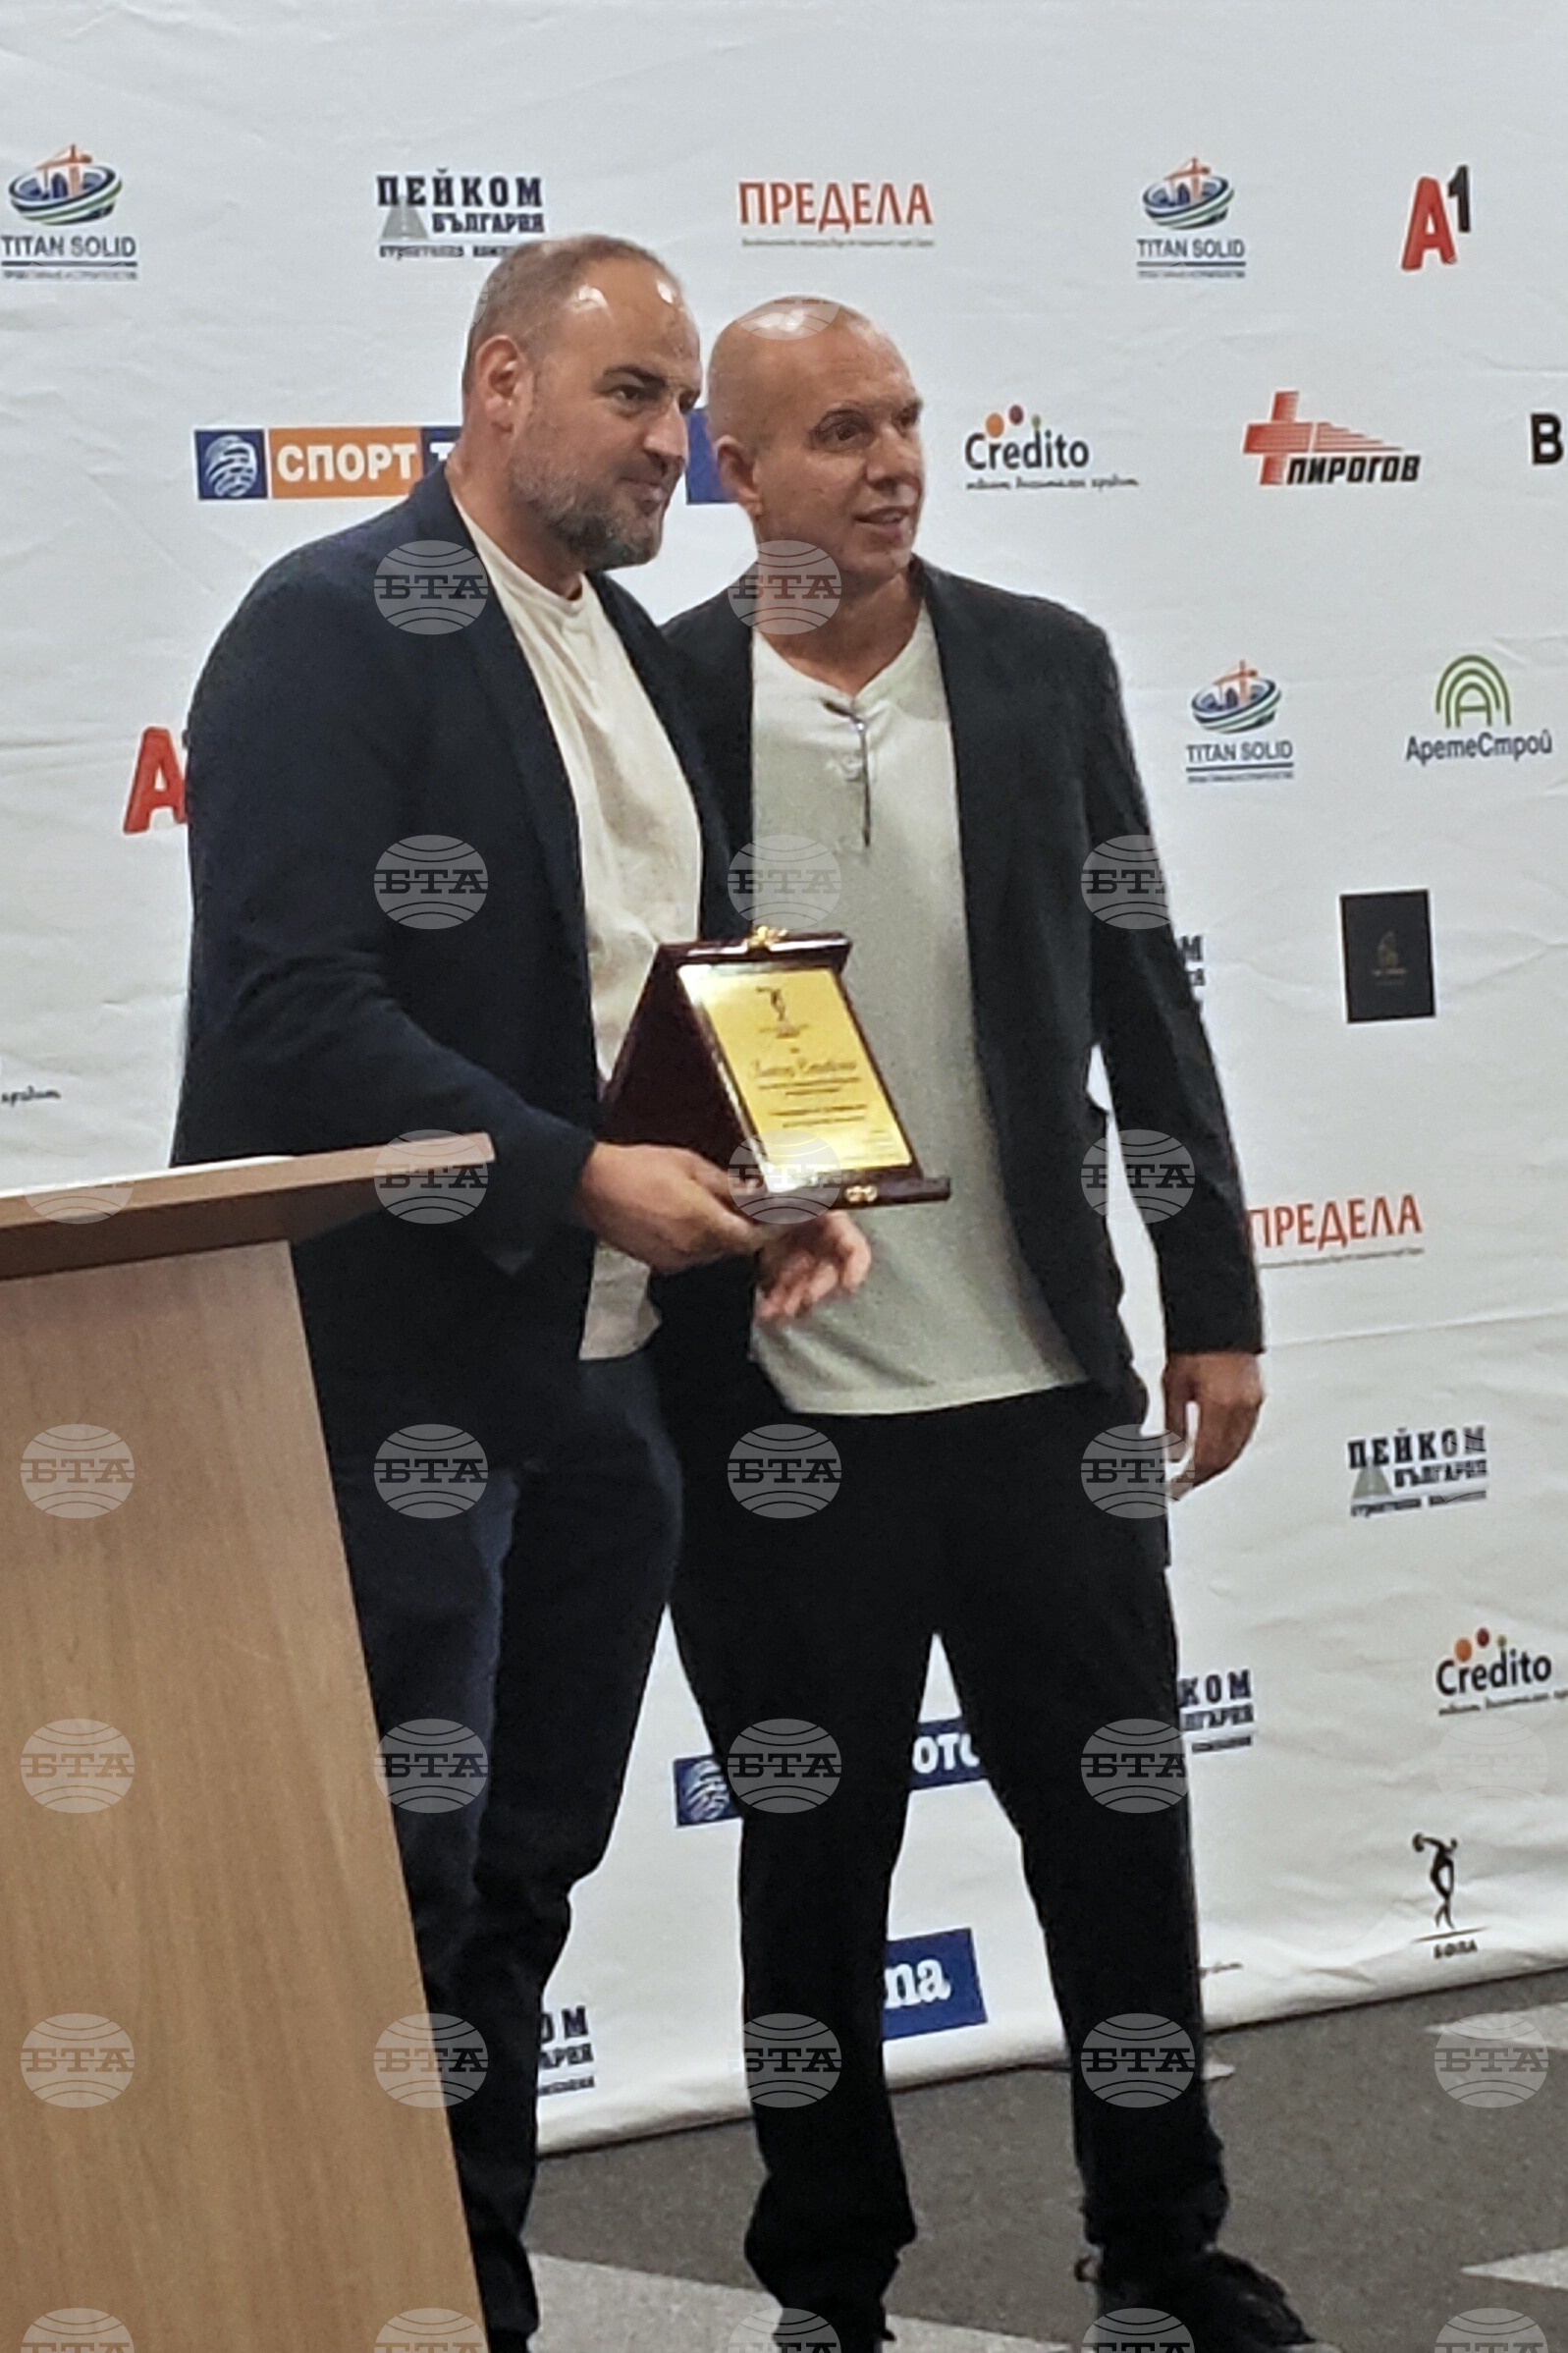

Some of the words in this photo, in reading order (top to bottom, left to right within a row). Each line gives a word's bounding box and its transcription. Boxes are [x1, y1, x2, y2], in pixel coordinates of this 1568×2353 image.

[376, 167, 542, 207] ПЕЙКОМ
[432, 213, 544, 234] БЪЛГАРИЯ
[739, 182, 933, 234] ПРЕДЕЛА
[1401, 164, 1471, 270] A1
[0, 236, 65, 256] TITAN
[71, 236, 136, 256] SOLID
[1137, 239, 1187, 257] TITAN
[1193, 238, 1245, 257] SOLID
[277, 444, 416, 482] СПОРТ
[965, 428, 1089, 469] Credito
[1286, 456, 1421, 485] ПИРОГОВ
[1186, 743, 1236, 762] TITAN
[1241, 740, 1293, 761] SOLID
[1248, 1193, 1423, 1250] ПРЕДЕЛА
[1348, 1425, 1486, 1469] ПЕЙКОМ
[1436, 1648, 1551, 1696] Credito
